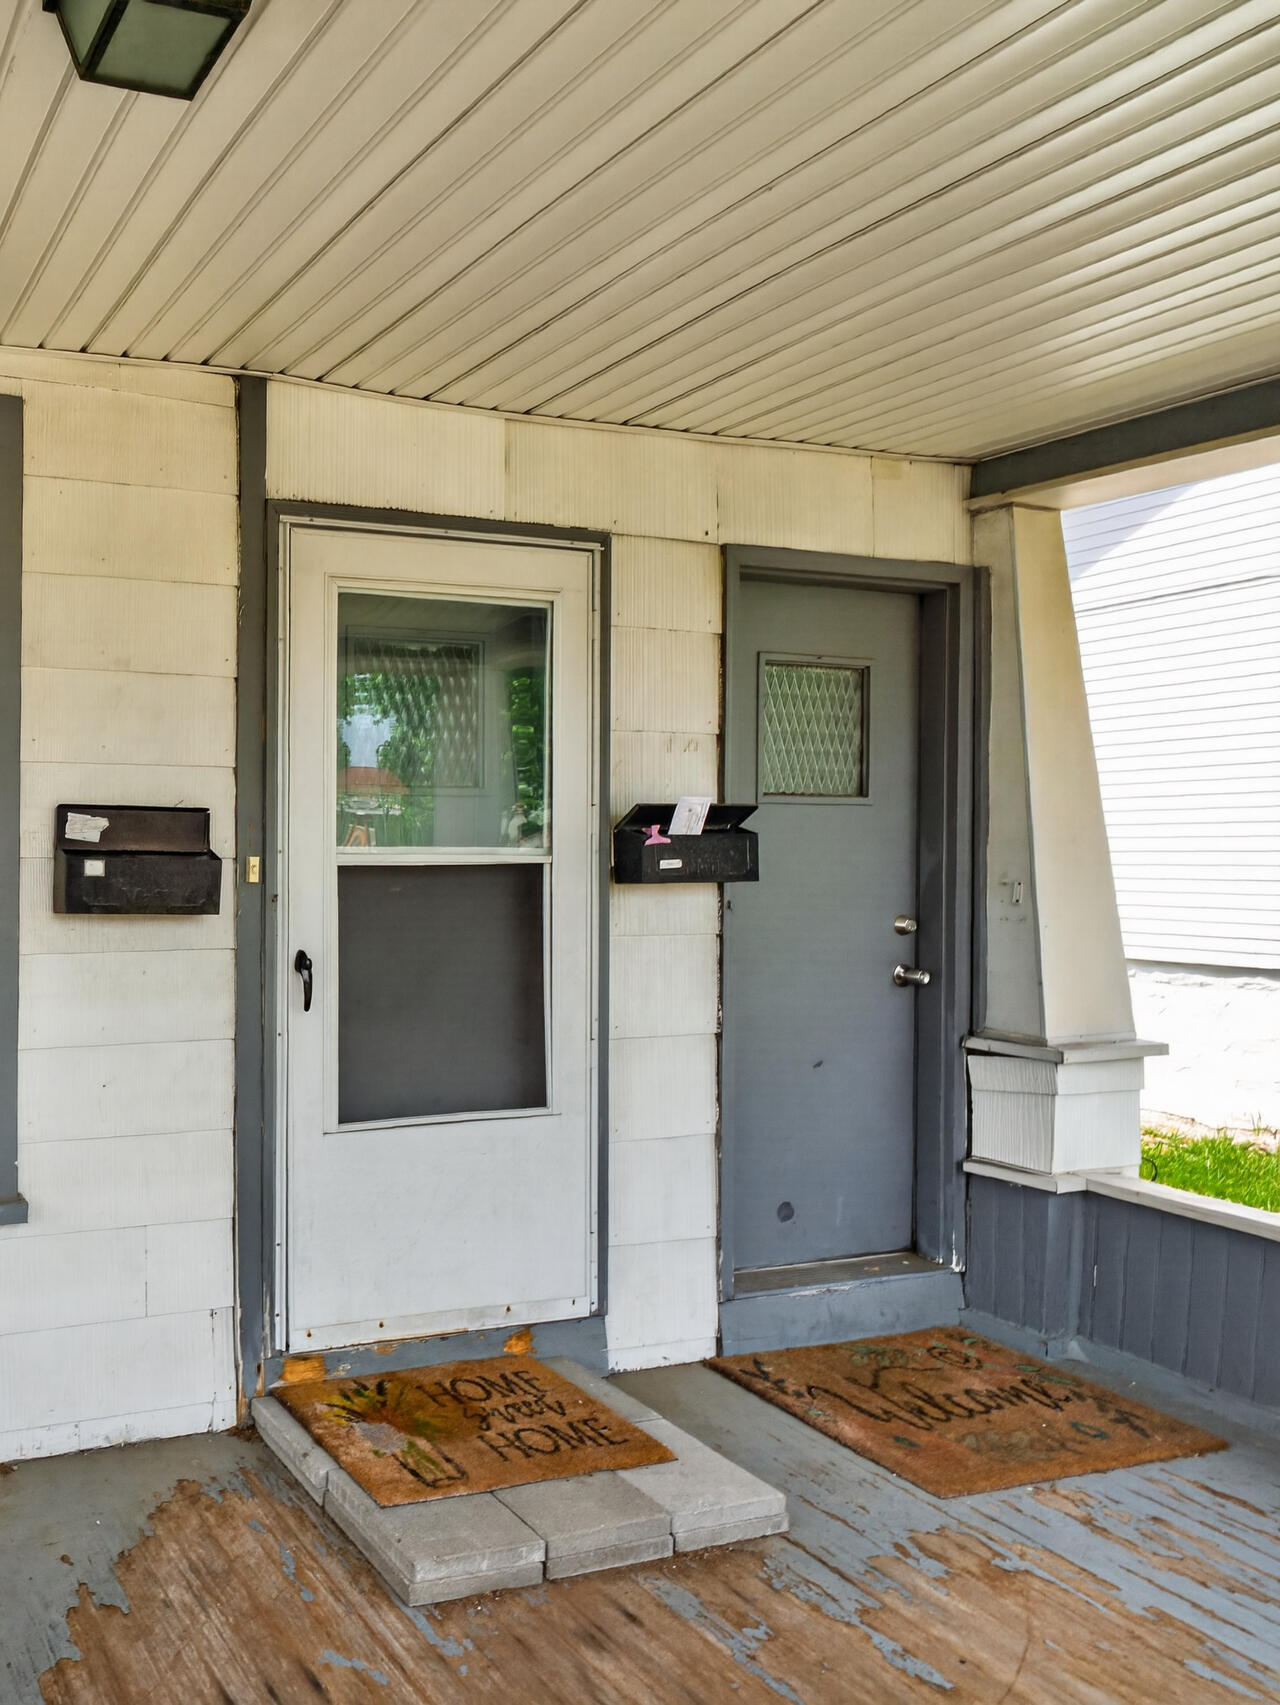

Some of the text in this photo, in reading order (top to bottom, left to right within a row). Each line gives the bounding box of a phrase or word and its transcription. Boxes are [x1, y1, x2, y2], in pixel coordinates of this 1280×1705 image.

[416, 1370, 548, 1408] HOME
[806, 1365, 1072, 1431] Welcome
[476, 1416, 630, 1463] HOME
